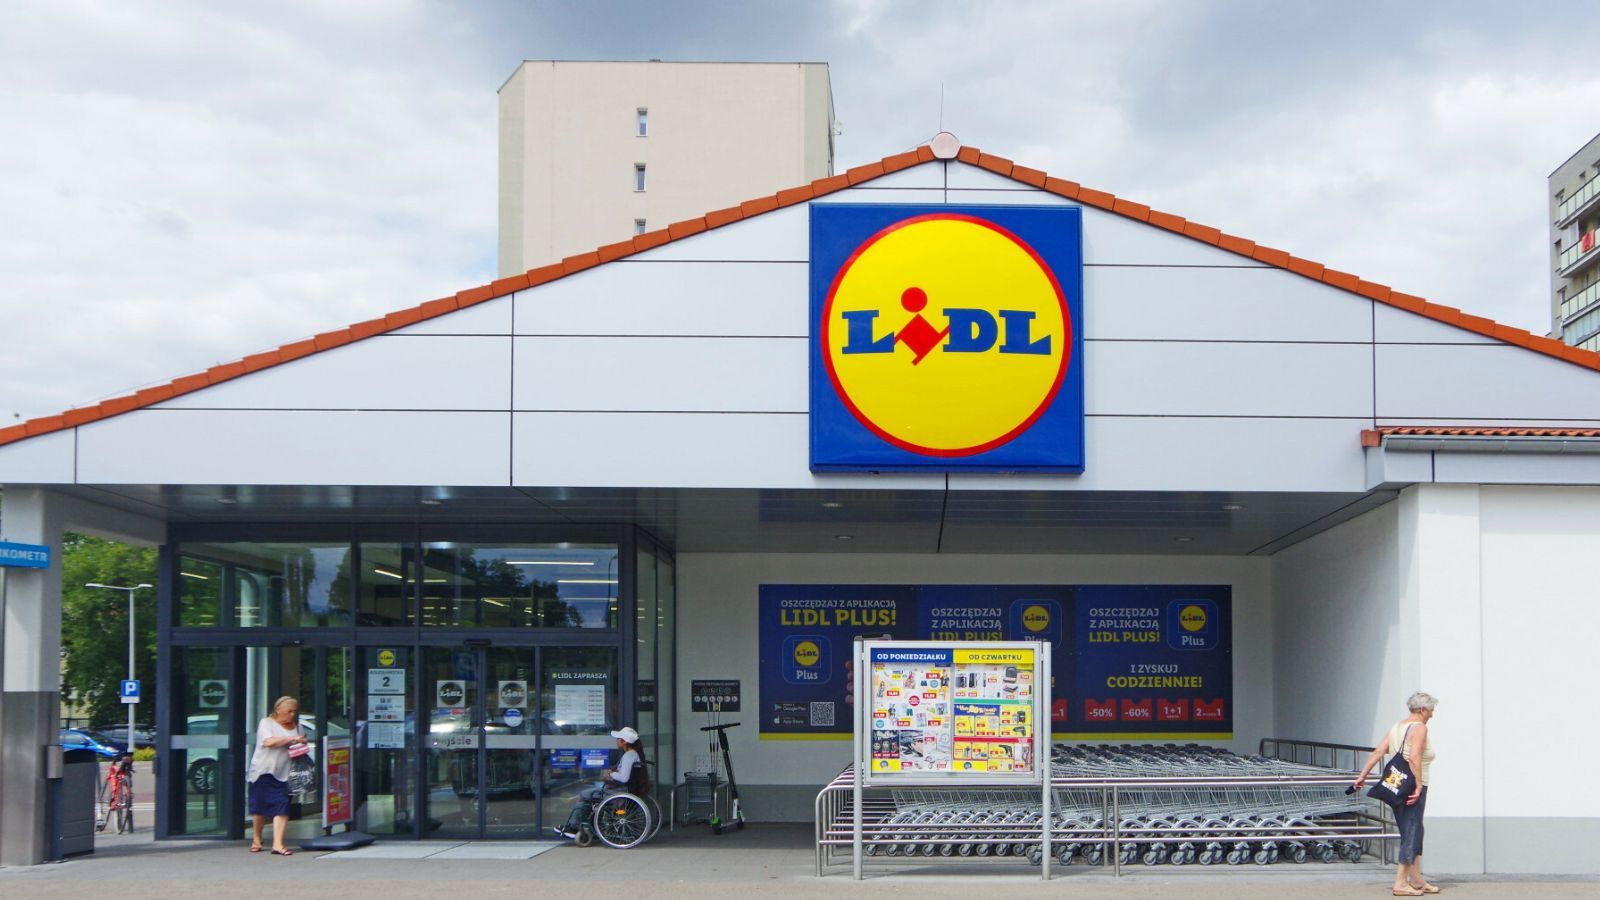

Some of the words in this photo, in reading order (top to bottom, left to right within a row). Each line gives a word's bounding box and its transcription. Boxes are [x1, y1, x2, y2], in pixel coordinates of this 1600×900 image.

[780, 599, 838, 609] OSZCZĘDZAJ
[840, 599, 845, 608] Z
[846, 599, 897, 609] APLIKACJĄ
[780, 609, 831, 626] LIDL
[835, 609, 897, 626] PLUS!
[931, 607, 1002, 619] OSZCZĘDZAJ
[1089, 607, 1160, 619] OSZCZĘDZAJ
[931, 619, 939, 629] Z
[940, 619, 1002, 630] APLIKACJĄ
[1089, 619, 1097, 629] Z
[1098, 619, 1160, 630] APLIKACJĄ
[931, 631, 961, 641] LIDL
[1089, 631, 1121, 642] LIDL
[1122, 631, 1160, 642] PLUS!
[1181, 635, 1205, 646] Plus
[1130, 664, 1136, 673] I
[1138, 664, 1178, 673] ZYSKUJ
[796, 670, 818, 680] Plus
[382, 676, 391, 687] 2
[1107, 675, 1203, 688] CODZIENNIE!
[125, 682, 137, 695] P
[1089, 708, 1113, 717] -50%
[1124, 708, 1149, 717] -60%
